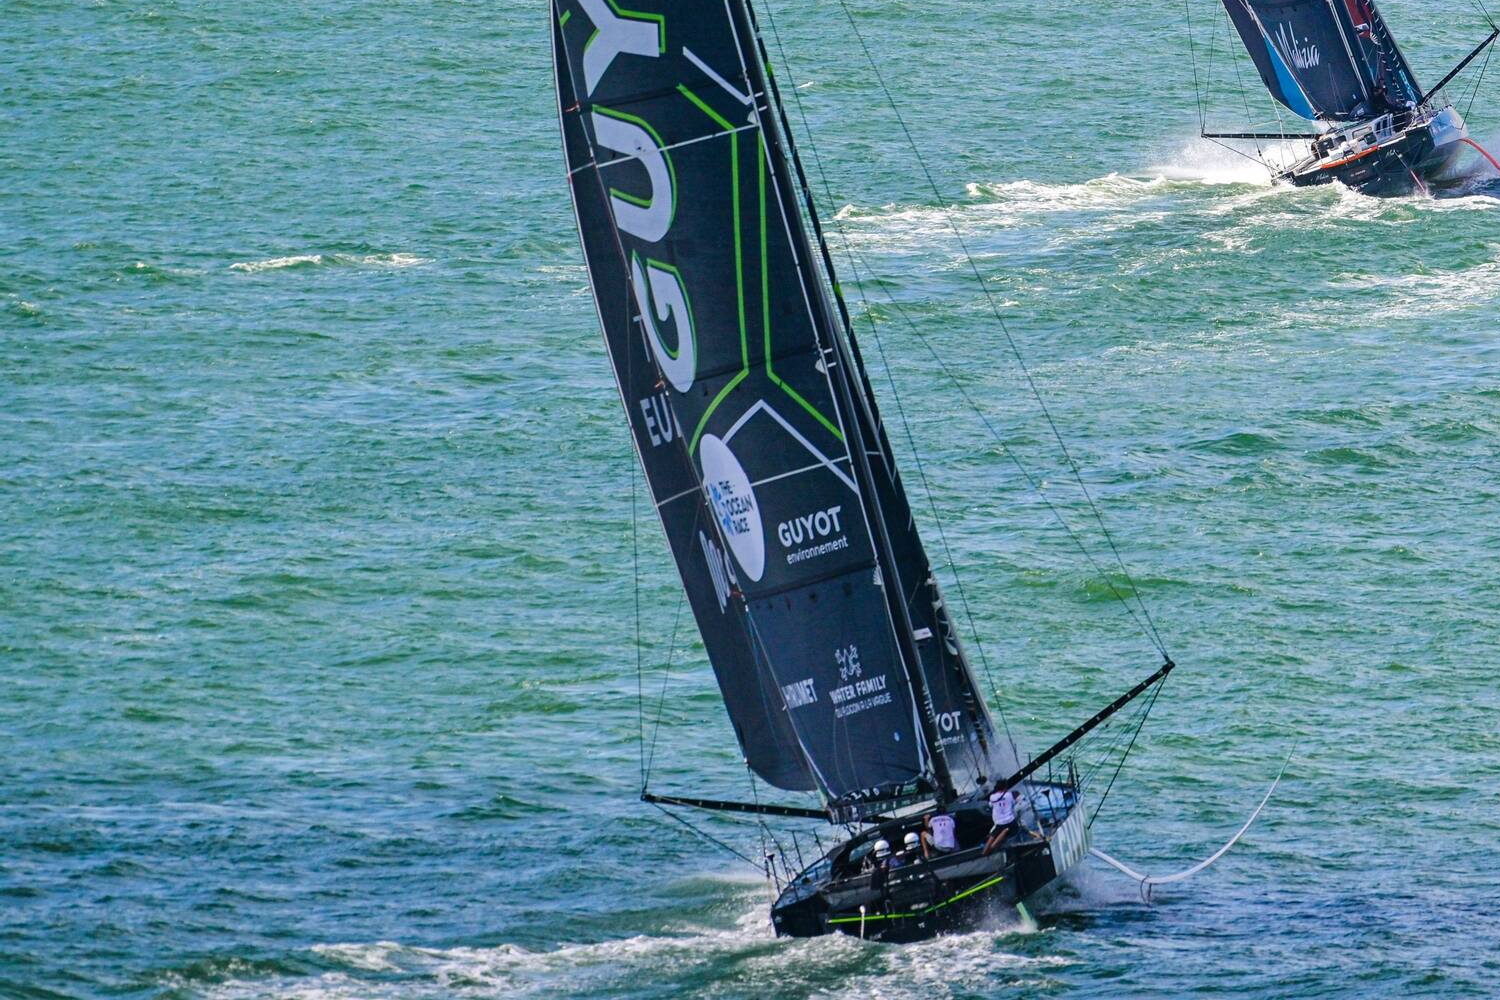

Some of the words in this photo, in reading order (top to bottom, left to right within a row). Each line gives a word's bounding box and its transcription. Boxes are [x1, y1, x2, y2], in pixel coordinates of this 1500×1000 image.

[640, 393, 682, 447] EU
[718, 480, 734, 495] THE
[726, 494, 753, 516] OCEAN
[733, 517, 751, 534] RACE
[778, 505, 841, 547] GUYOT
[786, 534, 849, 565] environnement
[829, 684, 856, 704] WATER
[855, 674, 887, 696] FAMILY
